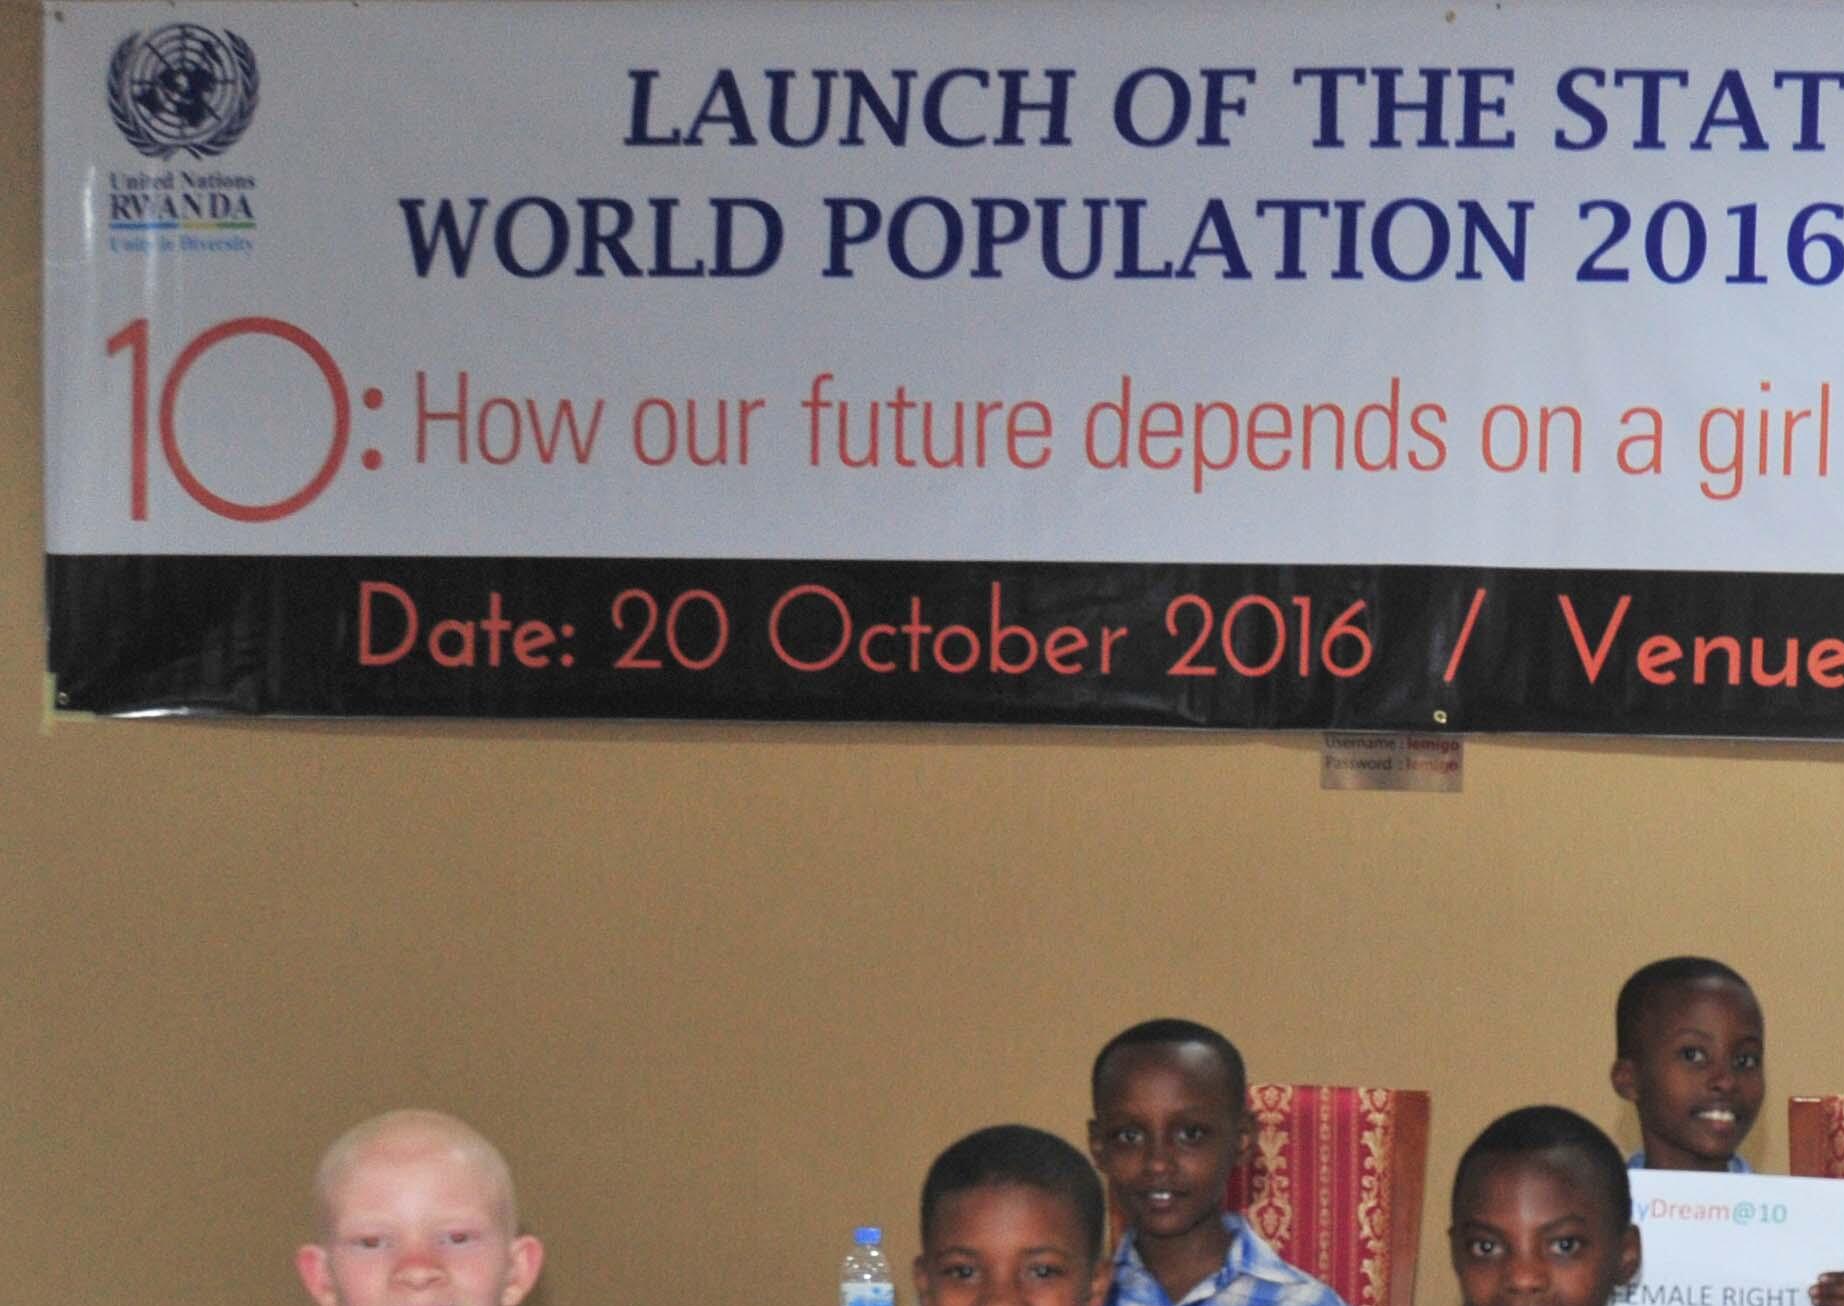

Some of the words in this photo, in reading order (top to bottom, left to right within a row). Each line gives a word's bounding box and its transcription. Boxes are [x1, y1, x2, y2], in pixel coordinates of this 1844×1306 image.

[624, 68, 1076, 148] LAUNCH
[1113, 67, 1256, 148] OF
[1293, 67, 1515, 148] THE
[182, 171, 255, 190] Nations
[398, 196, 783, 278] WORLD
[822, 196, 1534, 282] POPULATION
[106, 316, 384, 522] 10:
[416, 371, 605, 465] How
[633, 397, 765, 466] our
[801, 372, 1052, 469] future
[1084, 374, 1446, 493] depends
[1482, 404, 1582, 473] on
[1617, 407, 1662, 475] a
[1699, 381, 1829, 500] girl
[359, 581, 574, 668] Date:
[612, 589, 729, 670] 20
[769, 581, 1128, 675] October
[1166, 594, 1373, 677] 2016
[1443, 588, 1486, 684] /
[1633, 1199, 1787, 1224] yDream@10
